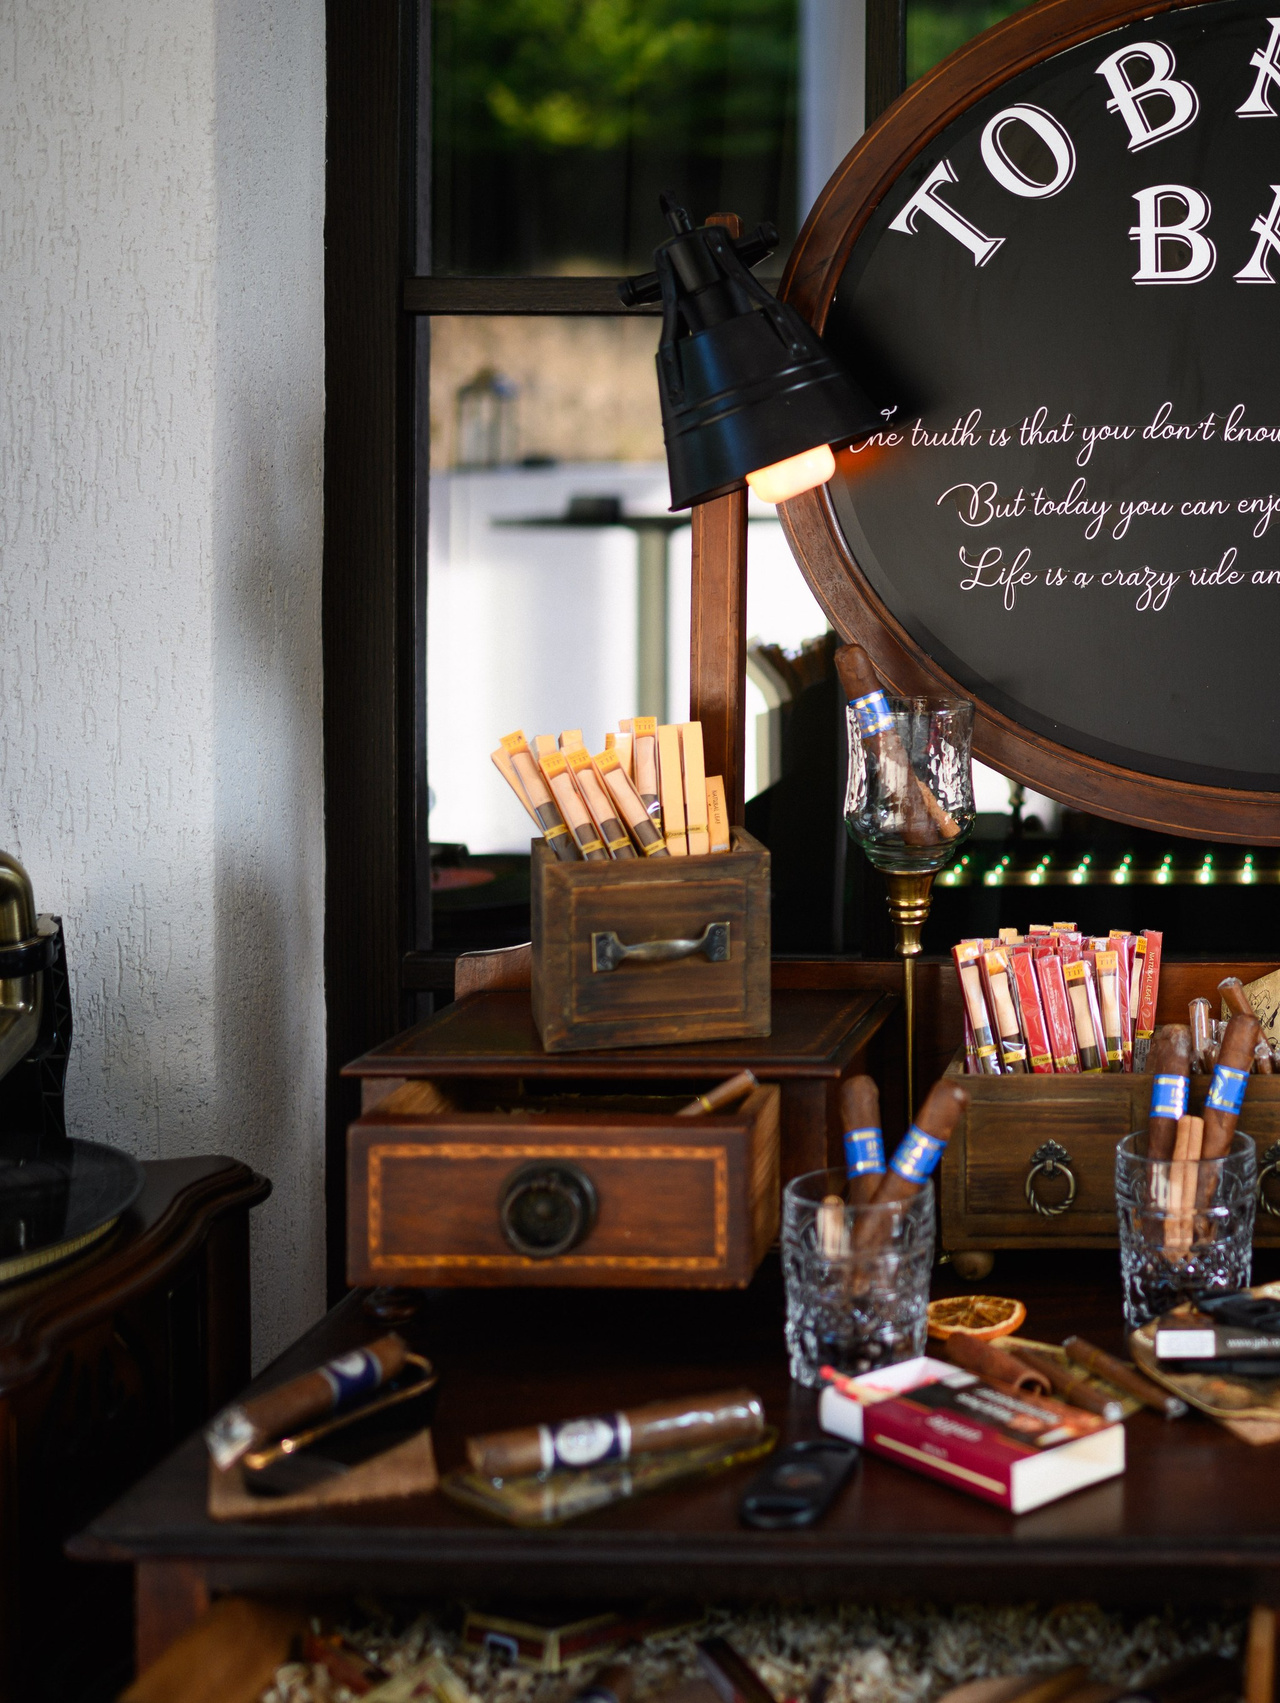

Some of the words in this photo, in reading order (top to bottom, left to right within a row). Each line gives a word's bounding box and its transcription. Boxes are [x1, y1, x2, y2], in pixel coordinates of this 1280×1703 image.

[911, 408, 982, 447] truth
[988, 428, 1012, 447] is
[1019, 405, 1075, 447] that
[1076, 425, 1136, 467] you
[1142, 401, 1216, 441] don't
[936, 481, 1026, 527] But
[1033, 476, 1109, 541] today
[1112, 500, 1174, 541] you
[1180, 500, 1231, 516] can
[958, 545, 1038, 611] Life
[1045, 567, 1068, 587] is
[1073, 572, 1095, 587] a
[1101, 565, 1181, 612] crazy
[1189, 546, 1246, 586] ride
[1144, 986, 1153, 1002] LEAF
[1146, 951, 1155, 986] NATURAL
